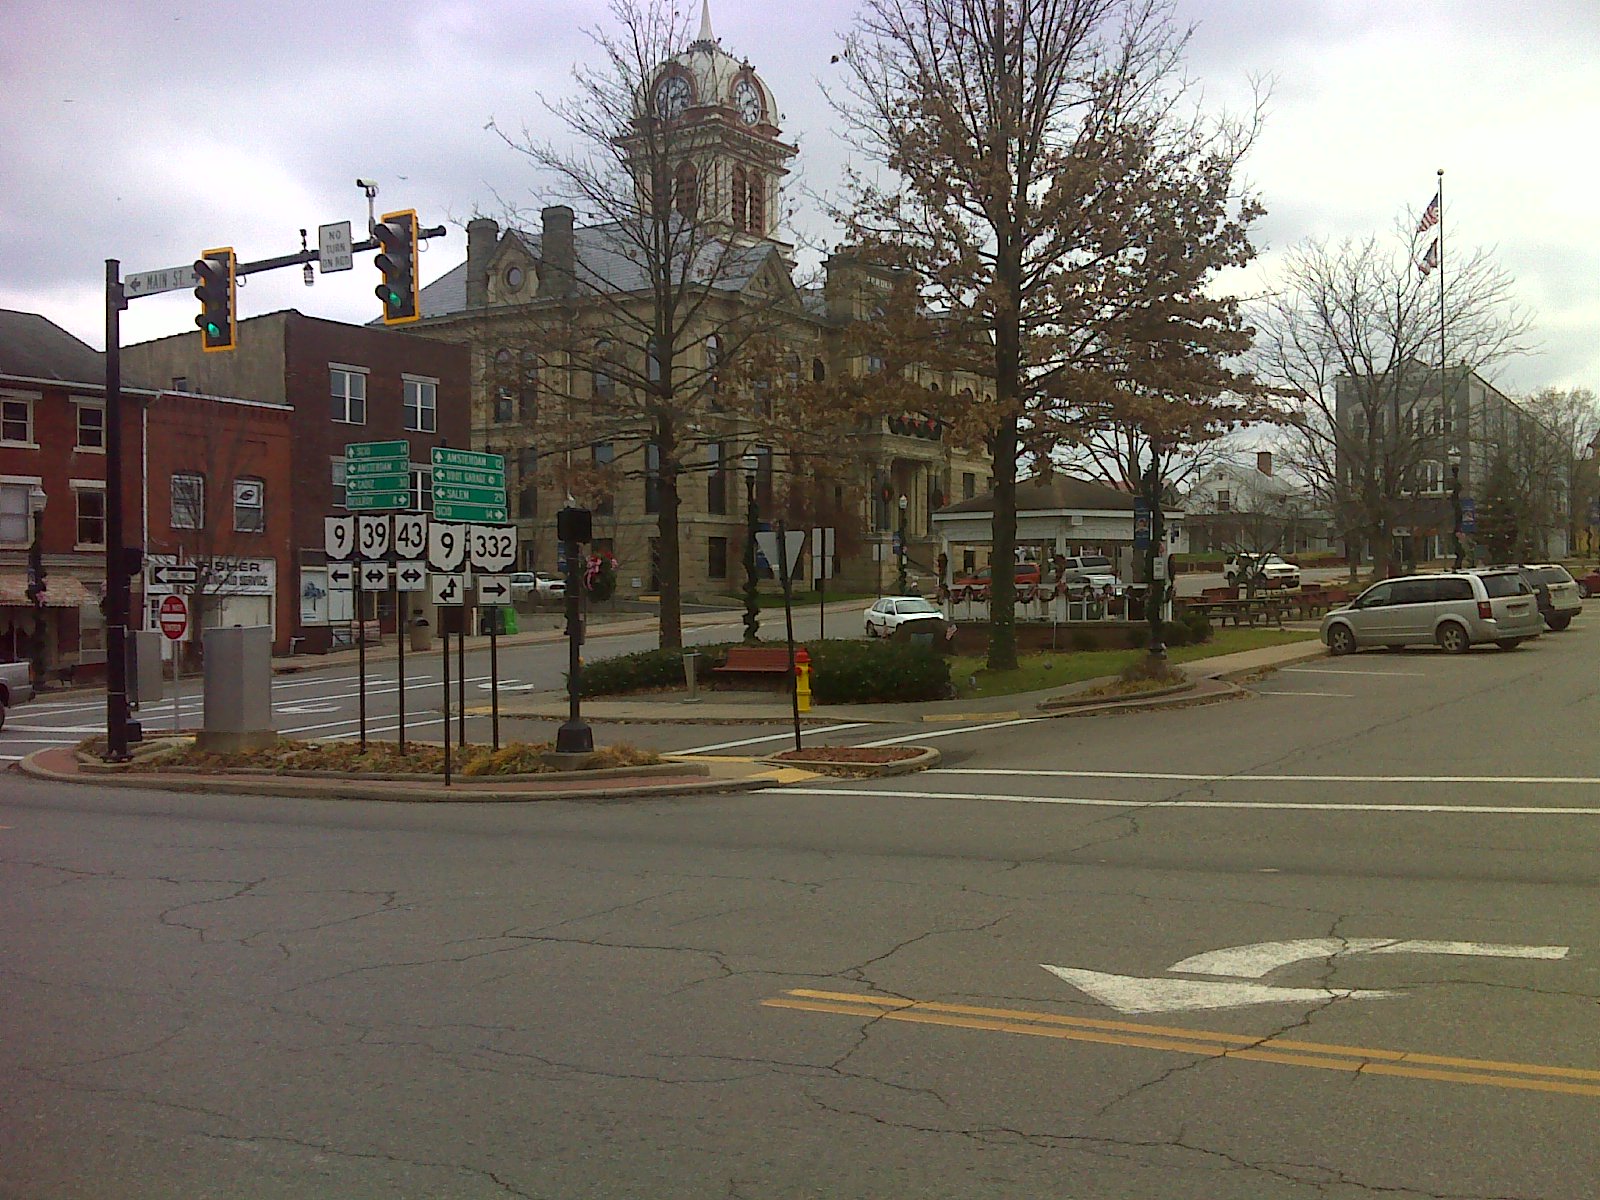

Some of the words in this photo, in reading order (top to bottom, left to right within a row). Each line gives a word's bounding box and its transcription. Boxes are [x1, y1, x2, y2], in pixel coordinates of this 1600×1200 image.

[329, 230, 341, 240] NO
[326, 243, 346, 254] TURN
[323, 258, 333, 268] ON
[335, 255, 349, 266] RED
[146, 272, 167, 290] MAIN
[446, 452, 487, 466] AMSTERDAM
[357, 461, 392, 473] AMSTERDAM
[446, 489, 469, 501] SALEM
[435, 505, 452, 517] SCIO
[335, 524, 345, 548] 9
[363, 522, 386, 548] 39
[398, 522, 422, 548] 43
[441, 532, 454, 559] 9
[475, 534, 512, 558] 332
